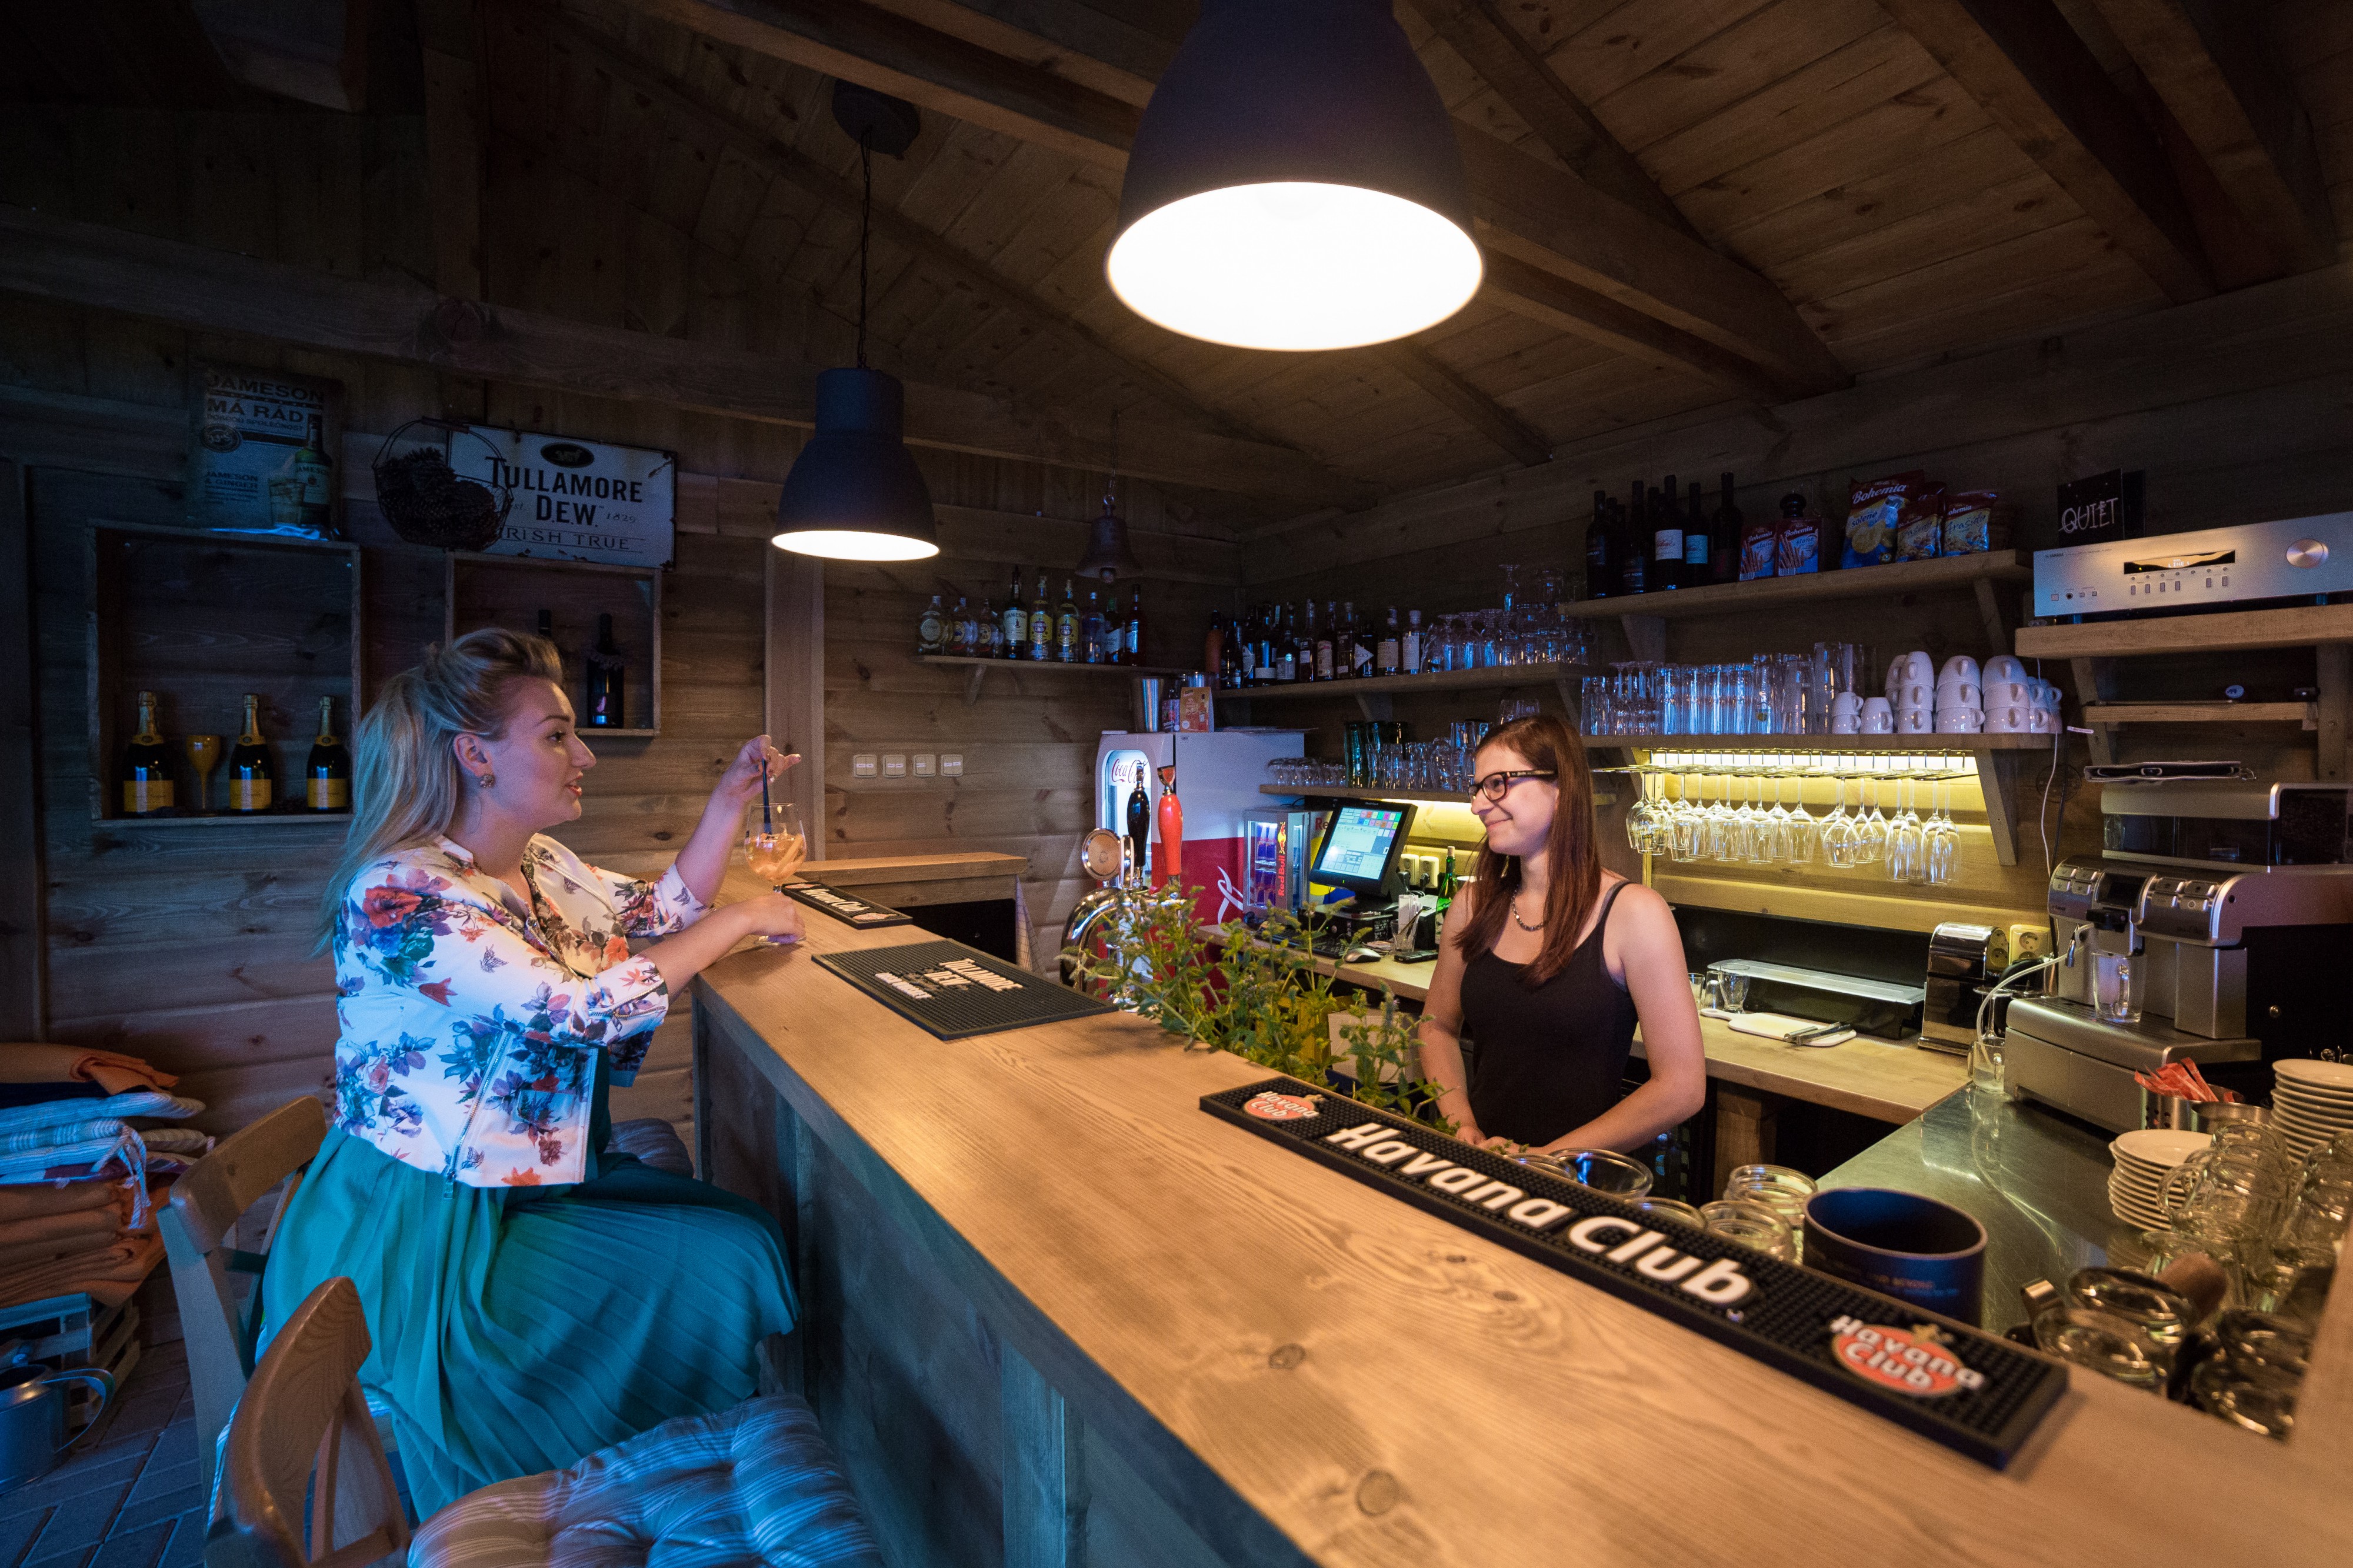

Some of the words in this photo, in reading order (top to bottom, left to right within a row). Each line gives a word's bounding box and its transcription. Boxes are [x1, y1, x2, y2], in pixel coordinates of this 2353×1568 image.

[208, 375, 324, 402] JAMESON
[254, 403, 304, 423] RÁD
[206, 471, 258, 482] JAMESON
[485, 456, 642, 503] TULLAMORE
[1852, 484, 1907, 504] Bohemia
[606, 513, 636, 524] 1829
[1948, 505, 1972, 516] ohemia
[2061, 497, 2119, 534] QUIET
[574, 533, 630, 551] TRUE
[1784, 526, 1813, 538] Bohemia
[1251, 1100, 1289, 1116] Club
[1256, 1090, 1319, 1117] Havana
[1325, 1122, 1575, 1229] Havana
[1569, 1216, 1752, 1304] Club
[1830, 1315, 1985, 1390] Havana
[1845, 1342, 1934, 1390] Club
